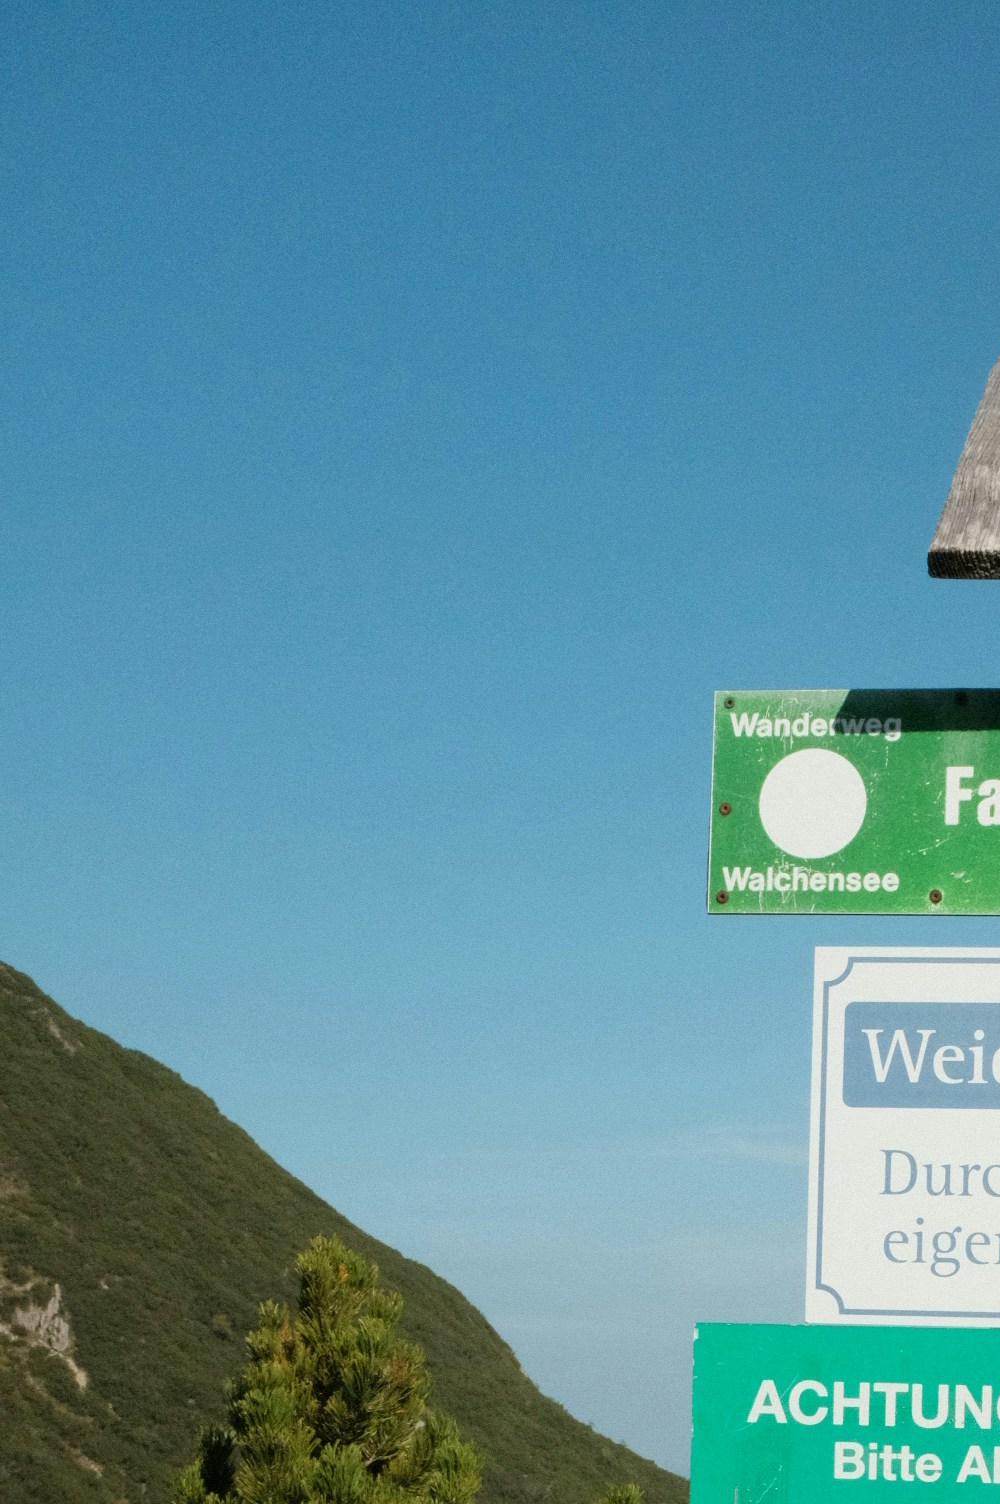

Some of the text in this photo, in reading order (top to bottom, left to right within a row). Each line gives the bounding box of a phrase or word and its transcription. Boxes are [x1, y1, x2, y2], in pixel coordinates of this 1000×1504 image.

[730, 711, 902, 742] Wanderweg
[722, 867, 900, 893] Walchensee
[832, 1441, 942, 1483] Bitte
